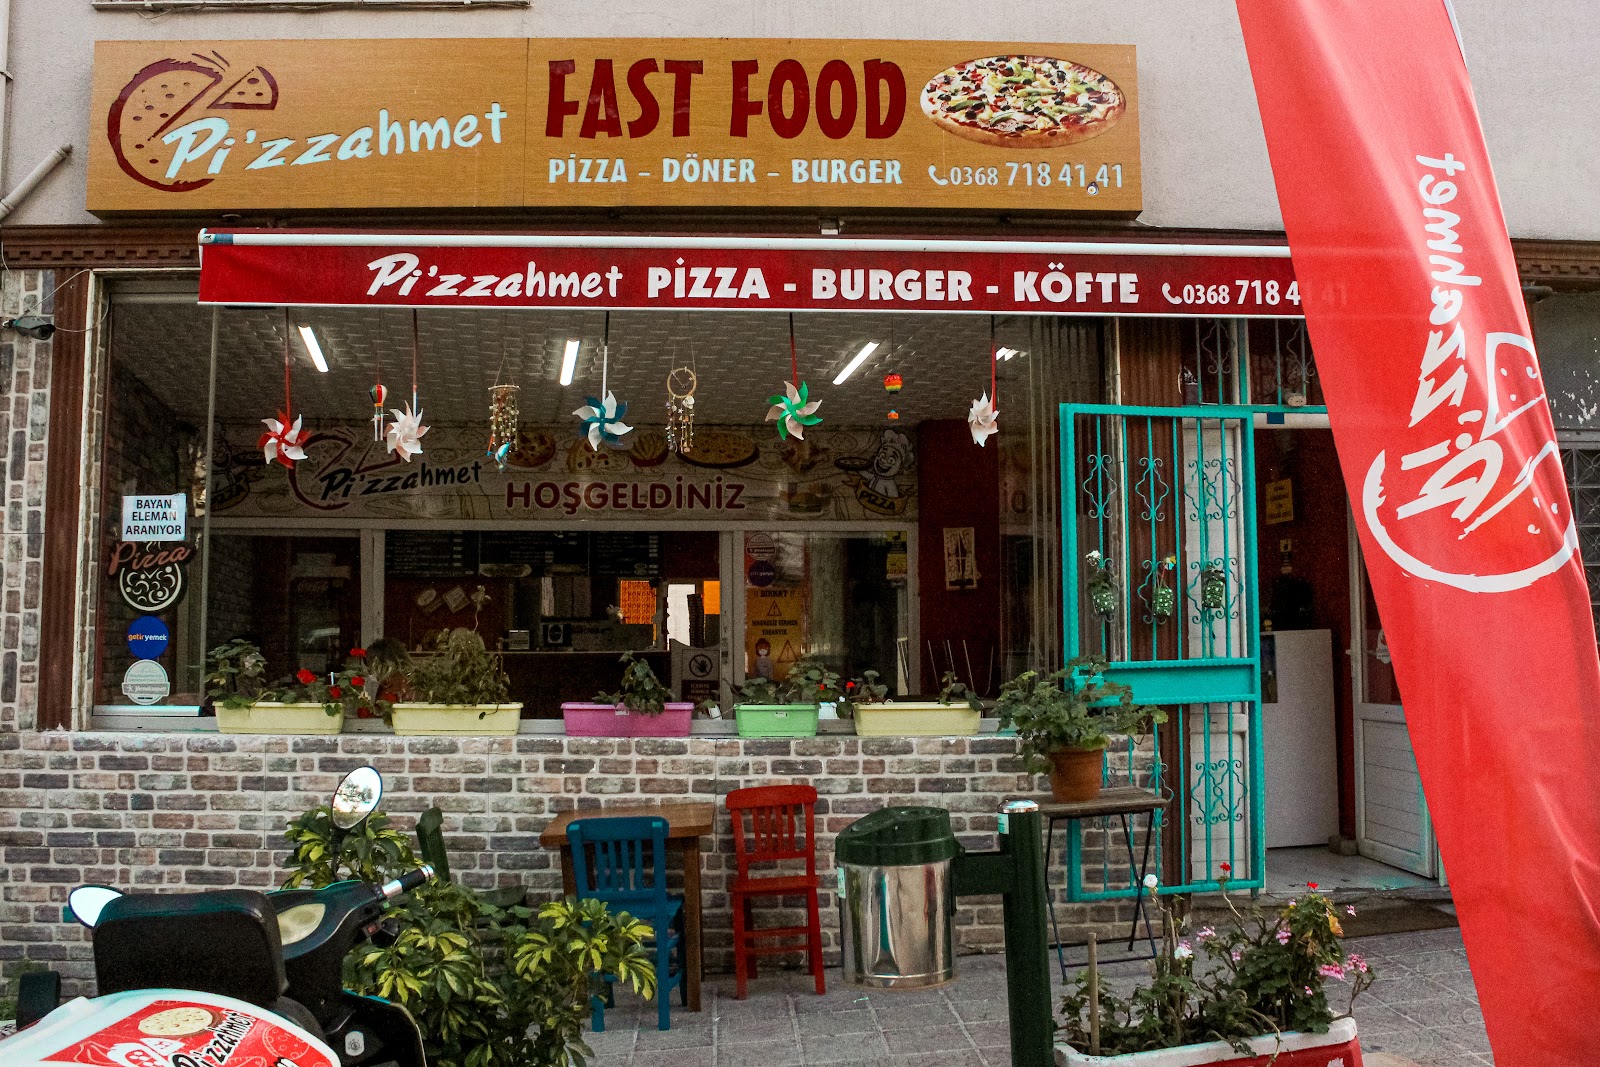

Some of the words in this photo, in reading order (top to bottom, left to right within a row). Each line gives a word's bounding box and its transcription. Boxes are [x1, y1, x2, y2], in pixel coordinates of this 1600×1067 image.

[545, 58, 704, 139] FAST
[729, 57, 908, 140] FOOD
[548, 152, 628, 184] PİZZA
[662, 152, 757, 184] DÖNER
[791, 158, 903, 185] BURGER
[949, 166, 999, 187] 0368
[1005, 161, 1052, 187] 718
[1058, 162, 1087, 188] 41
[1095, 163, 1124, 189] 41
[646, 257, 770, 300] PİZZA
[811, 268, 973, 303] BURGER
[1013, 262, 1140, 305] KÖFTE
[1182, 284, 1231, 305] 0368
[1235, 280, 1280, 305] 718
[136, 499, 172, 509] BAYAN
[505, 475, 748, 515] HOŞGELDİNİZ
[125, 525, 182, 535] ARANIYOR
[132, 511, 177, 521] ELEMAN
[109, 540, 191, 576] Pizza
